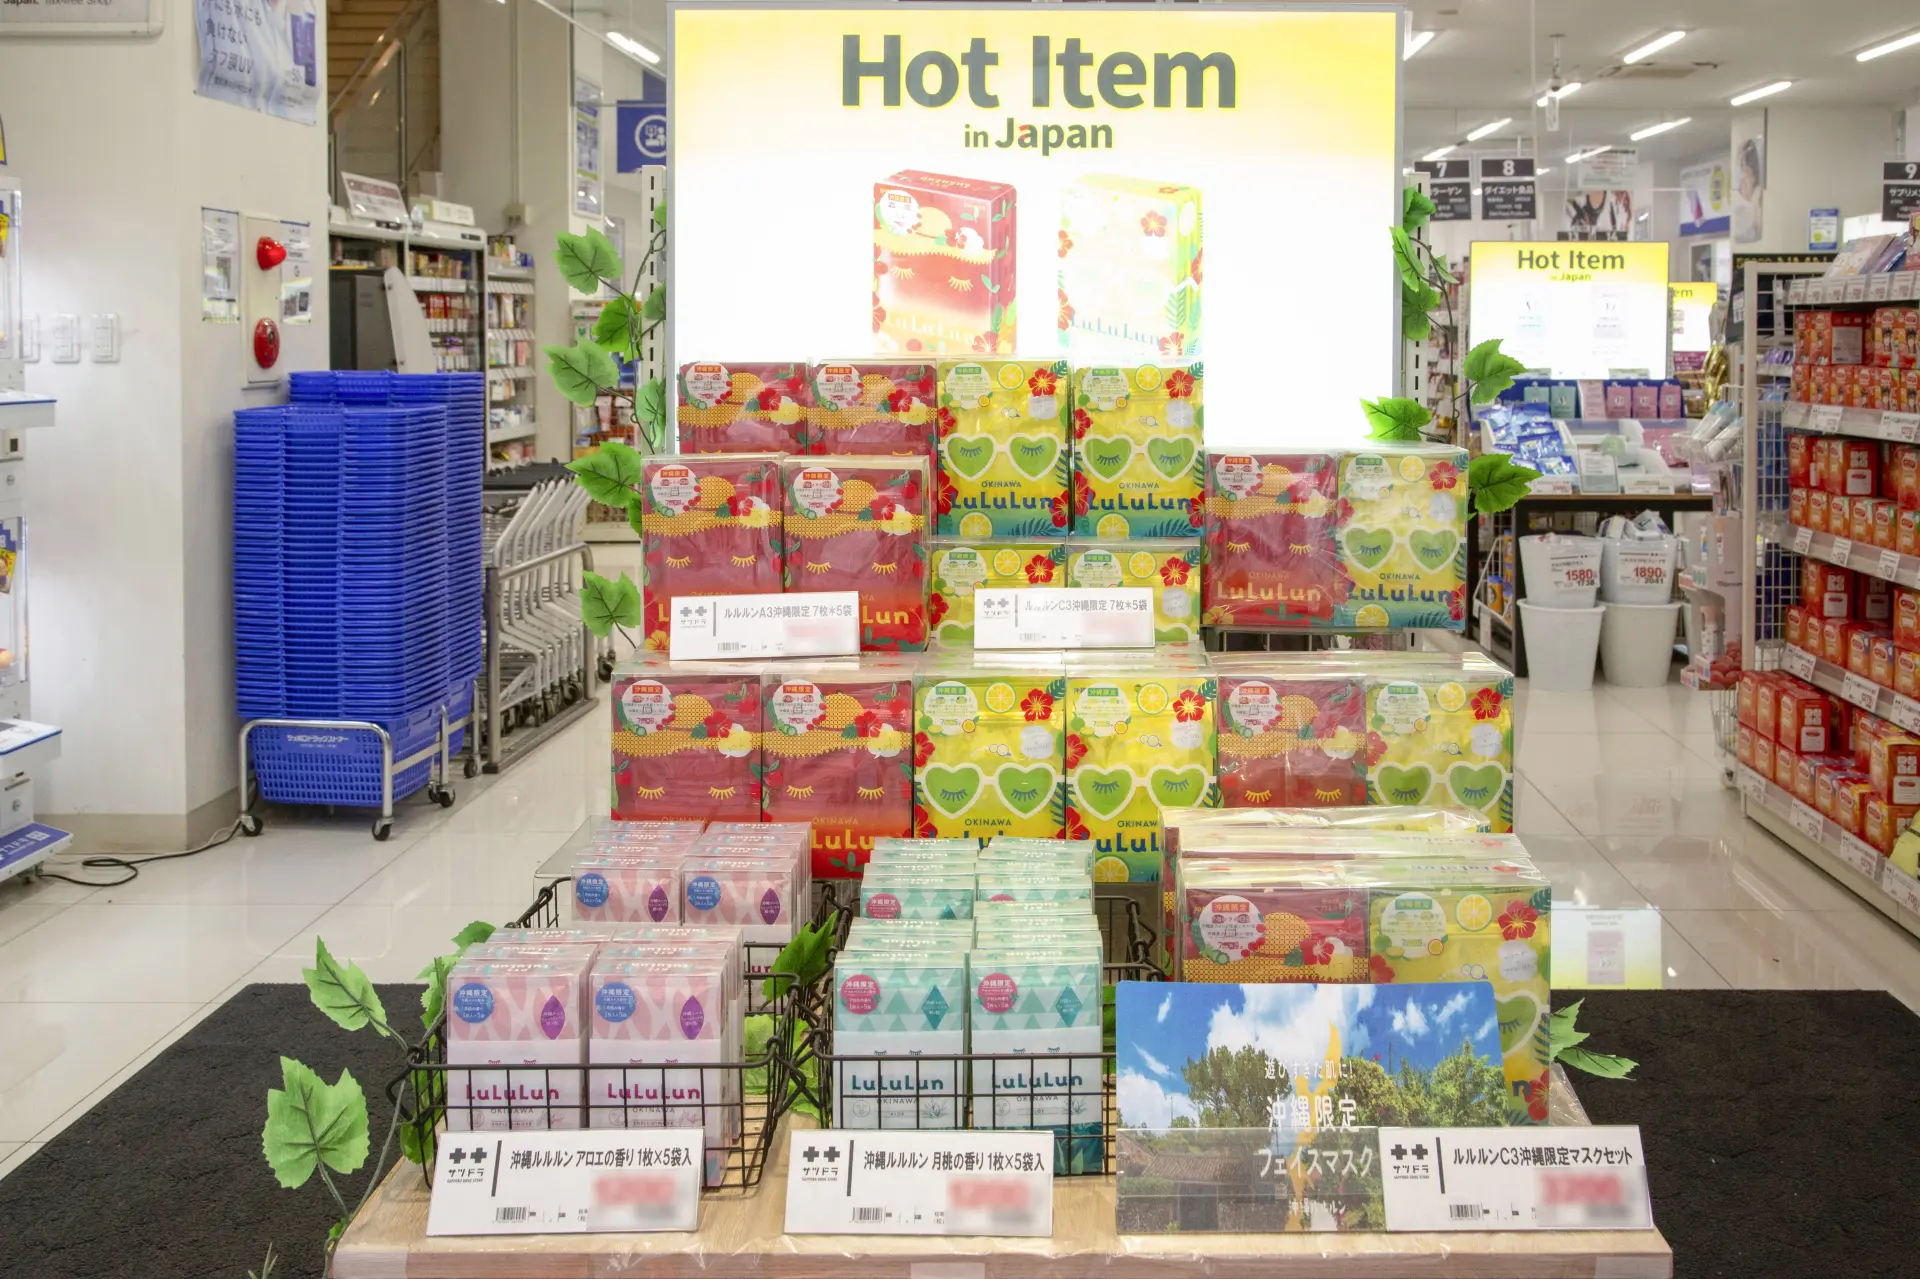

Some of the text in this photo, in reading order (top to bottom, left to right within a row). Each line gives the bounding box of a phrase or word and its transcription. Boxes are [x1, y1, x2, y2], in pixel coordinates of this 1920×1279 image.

[842, 34, 1236, 109] Hot Item
[964, 117, 1113, 157] in Japan
[1437, 162, 1447, 177] 7
[1503, 160, 1515, 176] 8
[1905, 164, 1917, 179] 9
[1430, 186, 1463, 196] ラーゲン
[1484, 184, 1534, 195] ダイエット食品
[1518, 250, 1625, 269] Hot Item
[1560, 273, 1591, 282] Japan
[981, 480, 1022, 488] OKINAWA
[1119, 482, 1160, 490] OKINAWA
[951, 492, 1055, 510] LuLuLun
[1089, 493, 1193, 511] LuLuLun
[1248, 571, 1290, 580] OKINAWA
[1379, 573, 1421, 581] OKINAWA
[1565, 569, 1593, 580] 1580
[1634, 567, 1662, 578] 1890
[1217, 581, 1321, 602] LuLuLun
[1348, 583, 1452, 603] LuLuLun
[724, 605, 811, 619] ルルルンA3沖縄限定
[812, 817, 859, 826] OKINAWA
[964, 818, 1012, 827] OKINAWA
[1117, 820, 1158, 828] OKINAW
[811, 829, 875, 849] LuLu
[460, 989, 488, 997] 沖縄限定
[852, 1075, 944, 1090] LuLuLun
[992, 1072, 1083, 1089] LuLuLun
[466, 1084, 559, 1100] LuLuLun
[607, 1083, 700, 1099] LuLuLun
[1266, 1094, 1360, 1133] 沖縄限定
[510, 1150, 573, 1170] 沖縄ルルルン
[576, 1149, 634, 1168] アロエの香り
[864, 1151, 928, 1171] 沖縄ルルルン
[932, 1152, 985, 1172] 月桃の香り
[1256, 1145, 1373, 1178] フェイスマスク
[1453, 1146, 1633, 1166] ルルルンC3沖縄限定マスクセット
[448, 1168, 485, 1177] サツドラ
[802, 1167, 839, 1176] サツドラ
[1393, 1165, 1429, 1174] サツドラ
